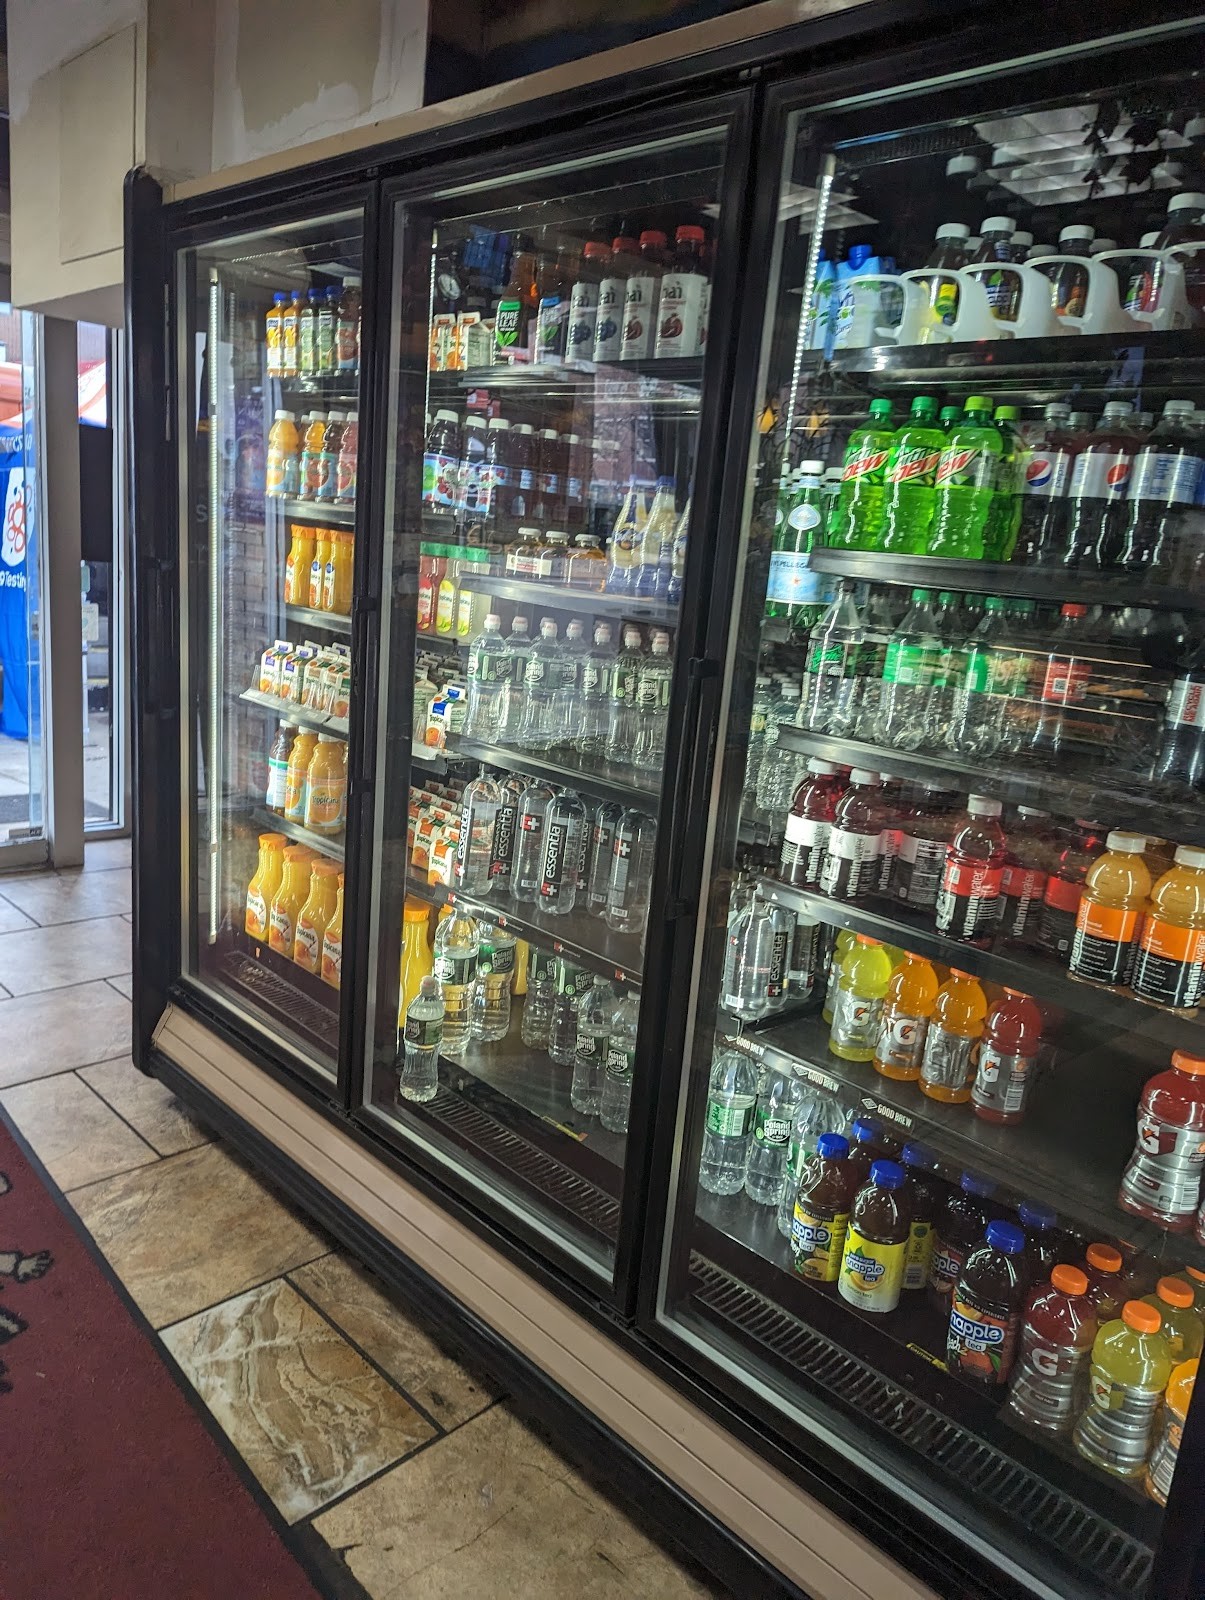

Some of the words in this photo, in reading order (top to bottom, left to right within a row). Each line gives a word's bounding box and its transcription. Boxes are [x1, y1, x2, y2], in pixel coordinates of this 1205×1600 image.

[499, 319, 518, 328] LEAF
[500, 311, 519, 320] PURE
[935, 450, 978, 484] EW
[1056, 462, 1066, 489] pepsi
[498, 807, 513, 857] essentia
[545, 825, 561, 879] essentia
[962, 869, 984, 937] vitaminwater
[1012, 872, 1035, 937] vitaminwater
[770, 934, 786, 982] essentia
[1182, 933, 1205, 1008] vitaminwater
[849, 1001, 872, 1027] G
[736, 1035, 751, 1050] GOOD
[893, 1019, 918, 1046] G
[607, 1050, 628, 1060] Poland
[607, 1057, 629, 1068] Spring
[981, 1049, 1001, 1083] G
[764, 1120, 791, 1129] Poland
[877, 1103, 896, 1120] GOOD
[893, 1111, 913, 1128] BREW
[764, 1127, 791, 1138] Spring
[1137, 1119, 1160, 1155] G
[800, 1241, 812, 1252] tea
[967, 1340, 983, 1351] tea
[1031, 1348, 1059, 1377] G
